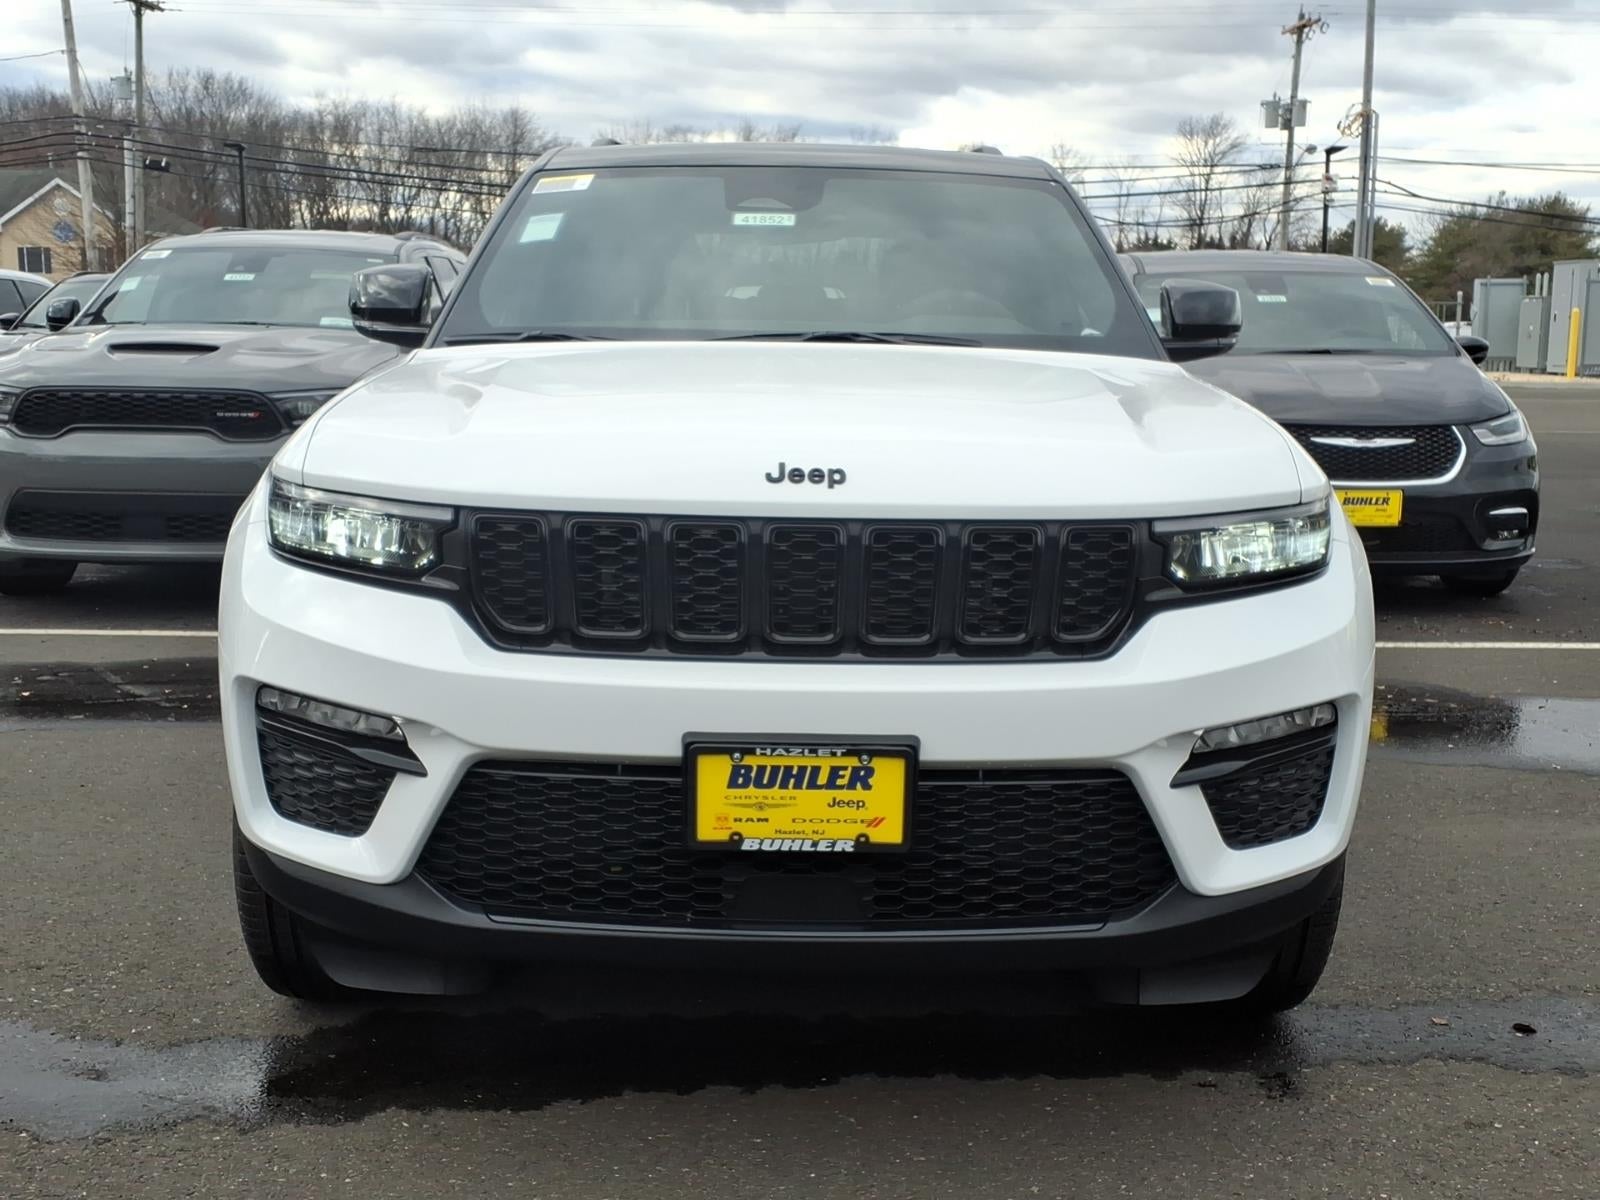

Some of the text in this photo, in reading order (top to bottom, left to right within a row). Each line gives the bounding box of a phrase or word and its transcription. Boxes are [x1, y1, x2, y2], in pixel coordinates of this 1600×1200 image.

[741, 215, 785, 225] 41852
[765, 462, 846, 489] Jeep
[1343, 496, 1391, 506] BUHLER
[755, 748, 847, 757] HAZLET
[727, 764, 875, 791] BUHLER
[827, 797, 866, 810] Jeep
[741, 838, 855, 852] BUHLER
